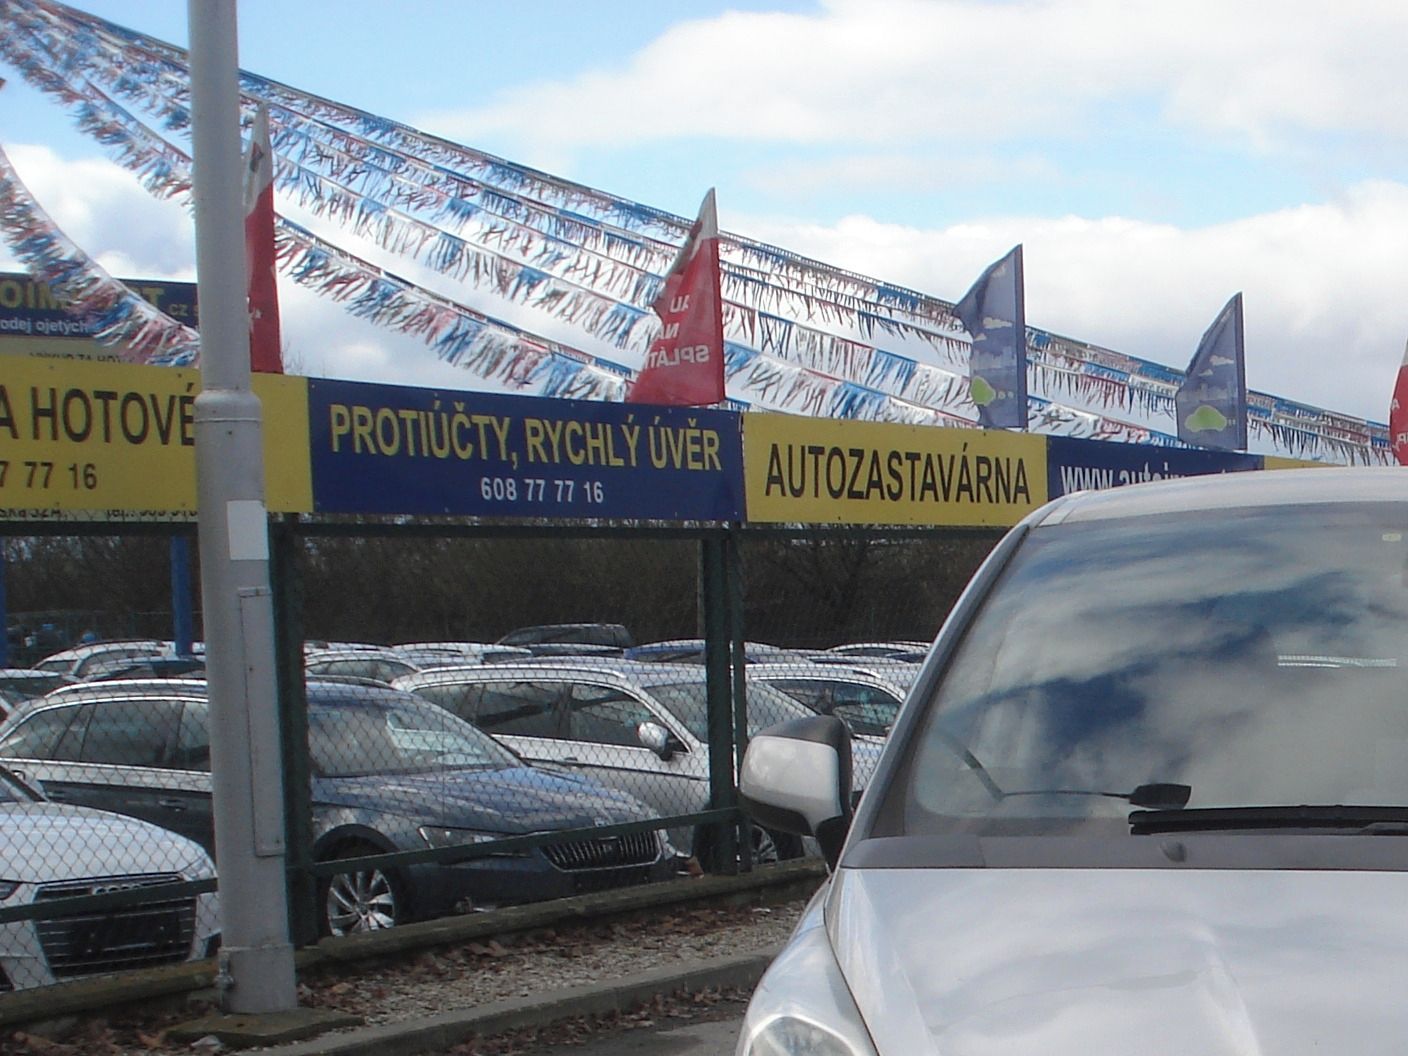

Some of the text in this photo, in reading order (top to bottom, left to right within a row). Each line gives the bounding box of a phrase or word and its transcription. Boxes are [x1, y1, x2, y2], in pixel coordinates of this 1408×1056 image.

[31, 382, 195, 447] HOTOVÉ
[330, 399, 722, 471] PROTIÚČTY, RYCHLÝ ÚVĚR
[24, 461, 53, 489] 77
[68, 462, 97, 490] 16
[481, 476, 604, 504] 608 77 77 16
[765, 443, 1031, 505] AUTOZASTAVÁRNA
